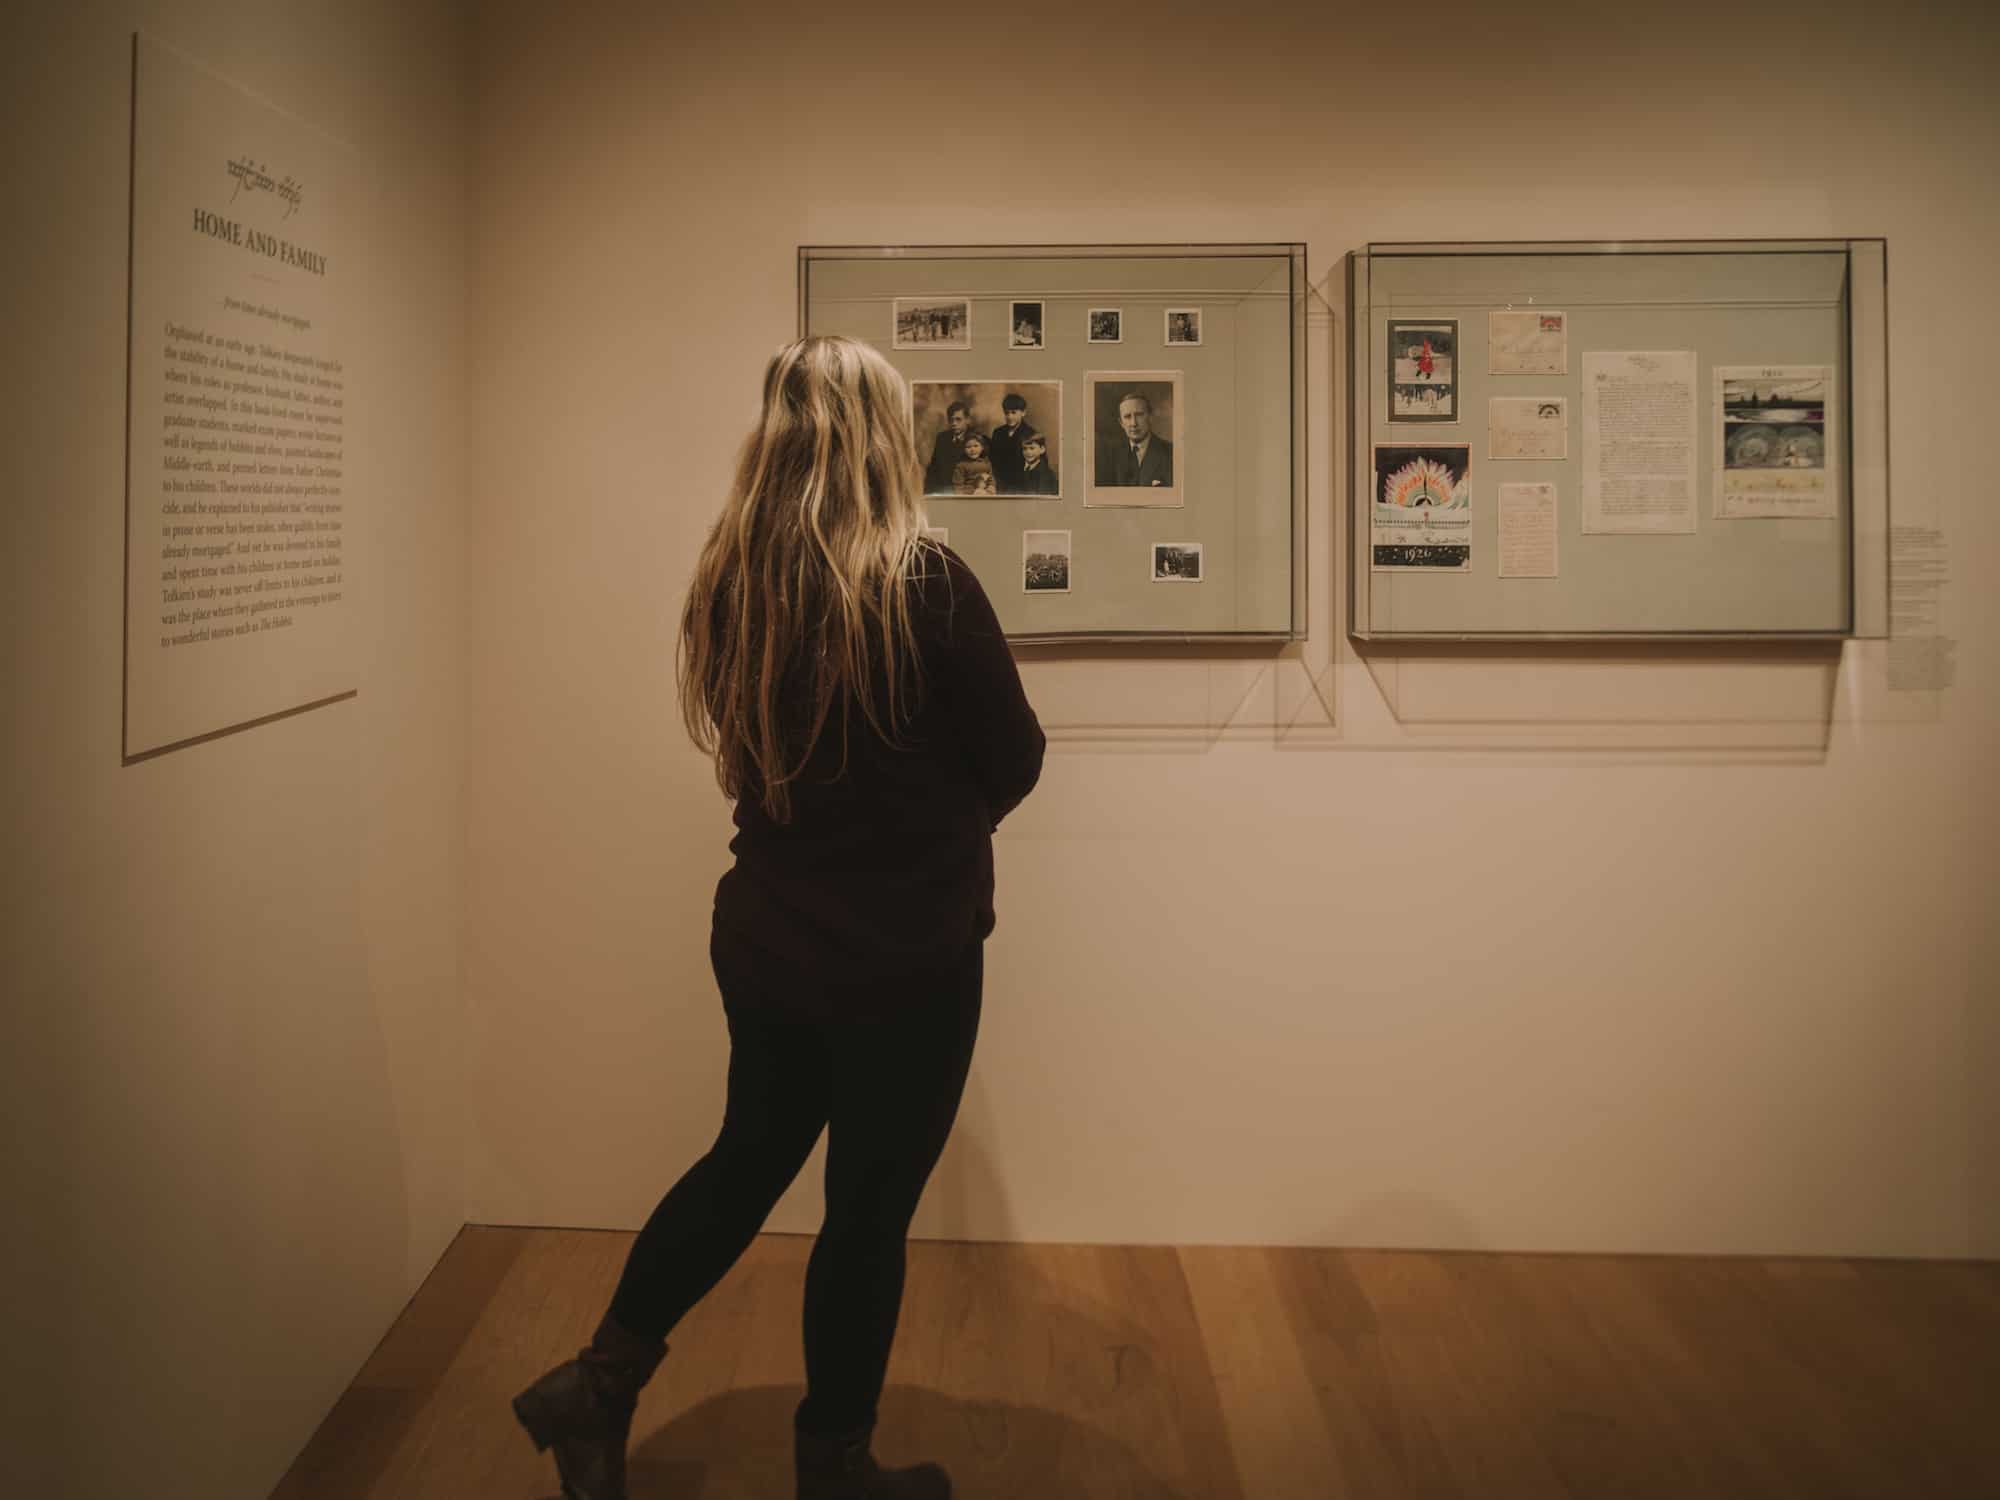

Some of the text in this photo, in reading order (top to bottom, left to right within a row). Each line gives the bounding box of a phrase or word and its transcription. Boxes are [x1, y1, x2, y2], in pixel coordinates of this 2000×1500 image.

[193, 208, 327, 276] HOME AND FAMILY
